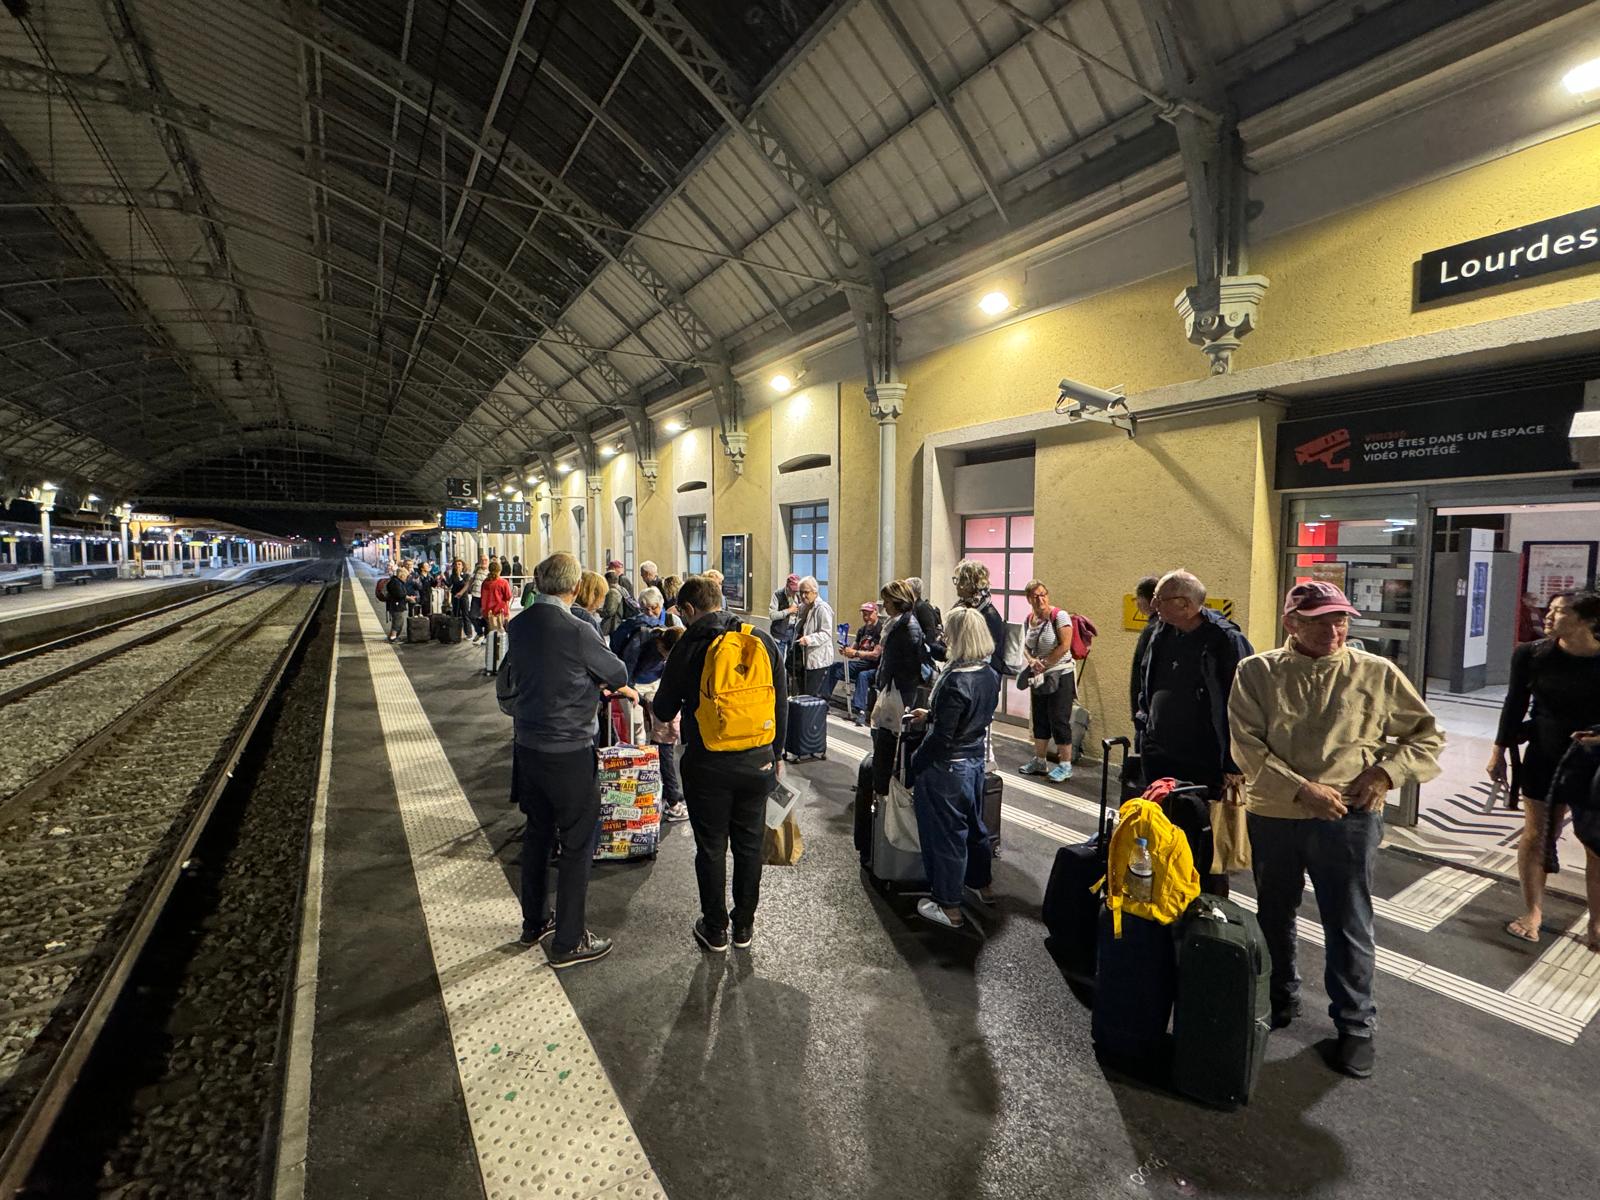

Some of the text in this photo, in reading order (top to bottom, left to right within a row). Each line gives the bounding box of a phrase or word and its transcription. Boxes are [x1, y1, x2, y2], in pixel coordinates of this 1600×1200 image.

[1440, 228, 1599, 284] Lourdes
[1363, 425, 1545, 451] VOUS ÊTES DANS UN ESPACE
[1363, 444, 1461, 462] VIDÉO PROTÉGÉ.
[462, 483, 472, 496] S
